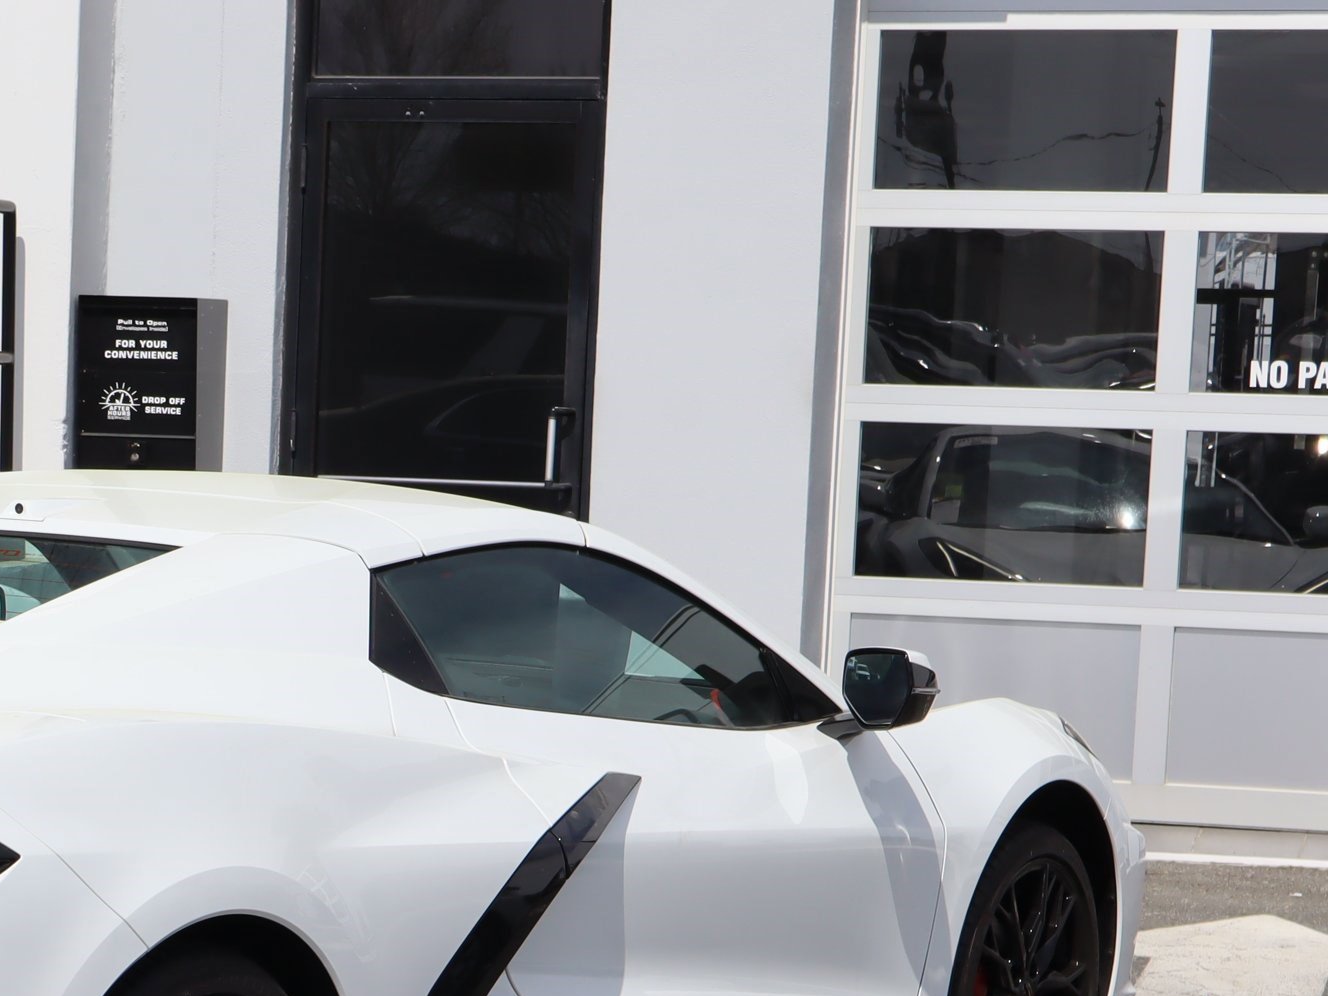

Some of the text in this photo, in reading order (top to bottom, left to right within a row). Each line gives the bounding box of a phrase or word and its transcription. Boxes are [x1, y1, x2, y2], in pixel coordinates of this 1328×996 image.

[115, 339, 168, 349] FOR YOUR
[104, 350, 179, 360] CONVENIENCE
[1249, 360, 1288, 389] NO
[141, 396, 186, 405] DROP OFF
[144, 406, 182, 415] SERVICE
